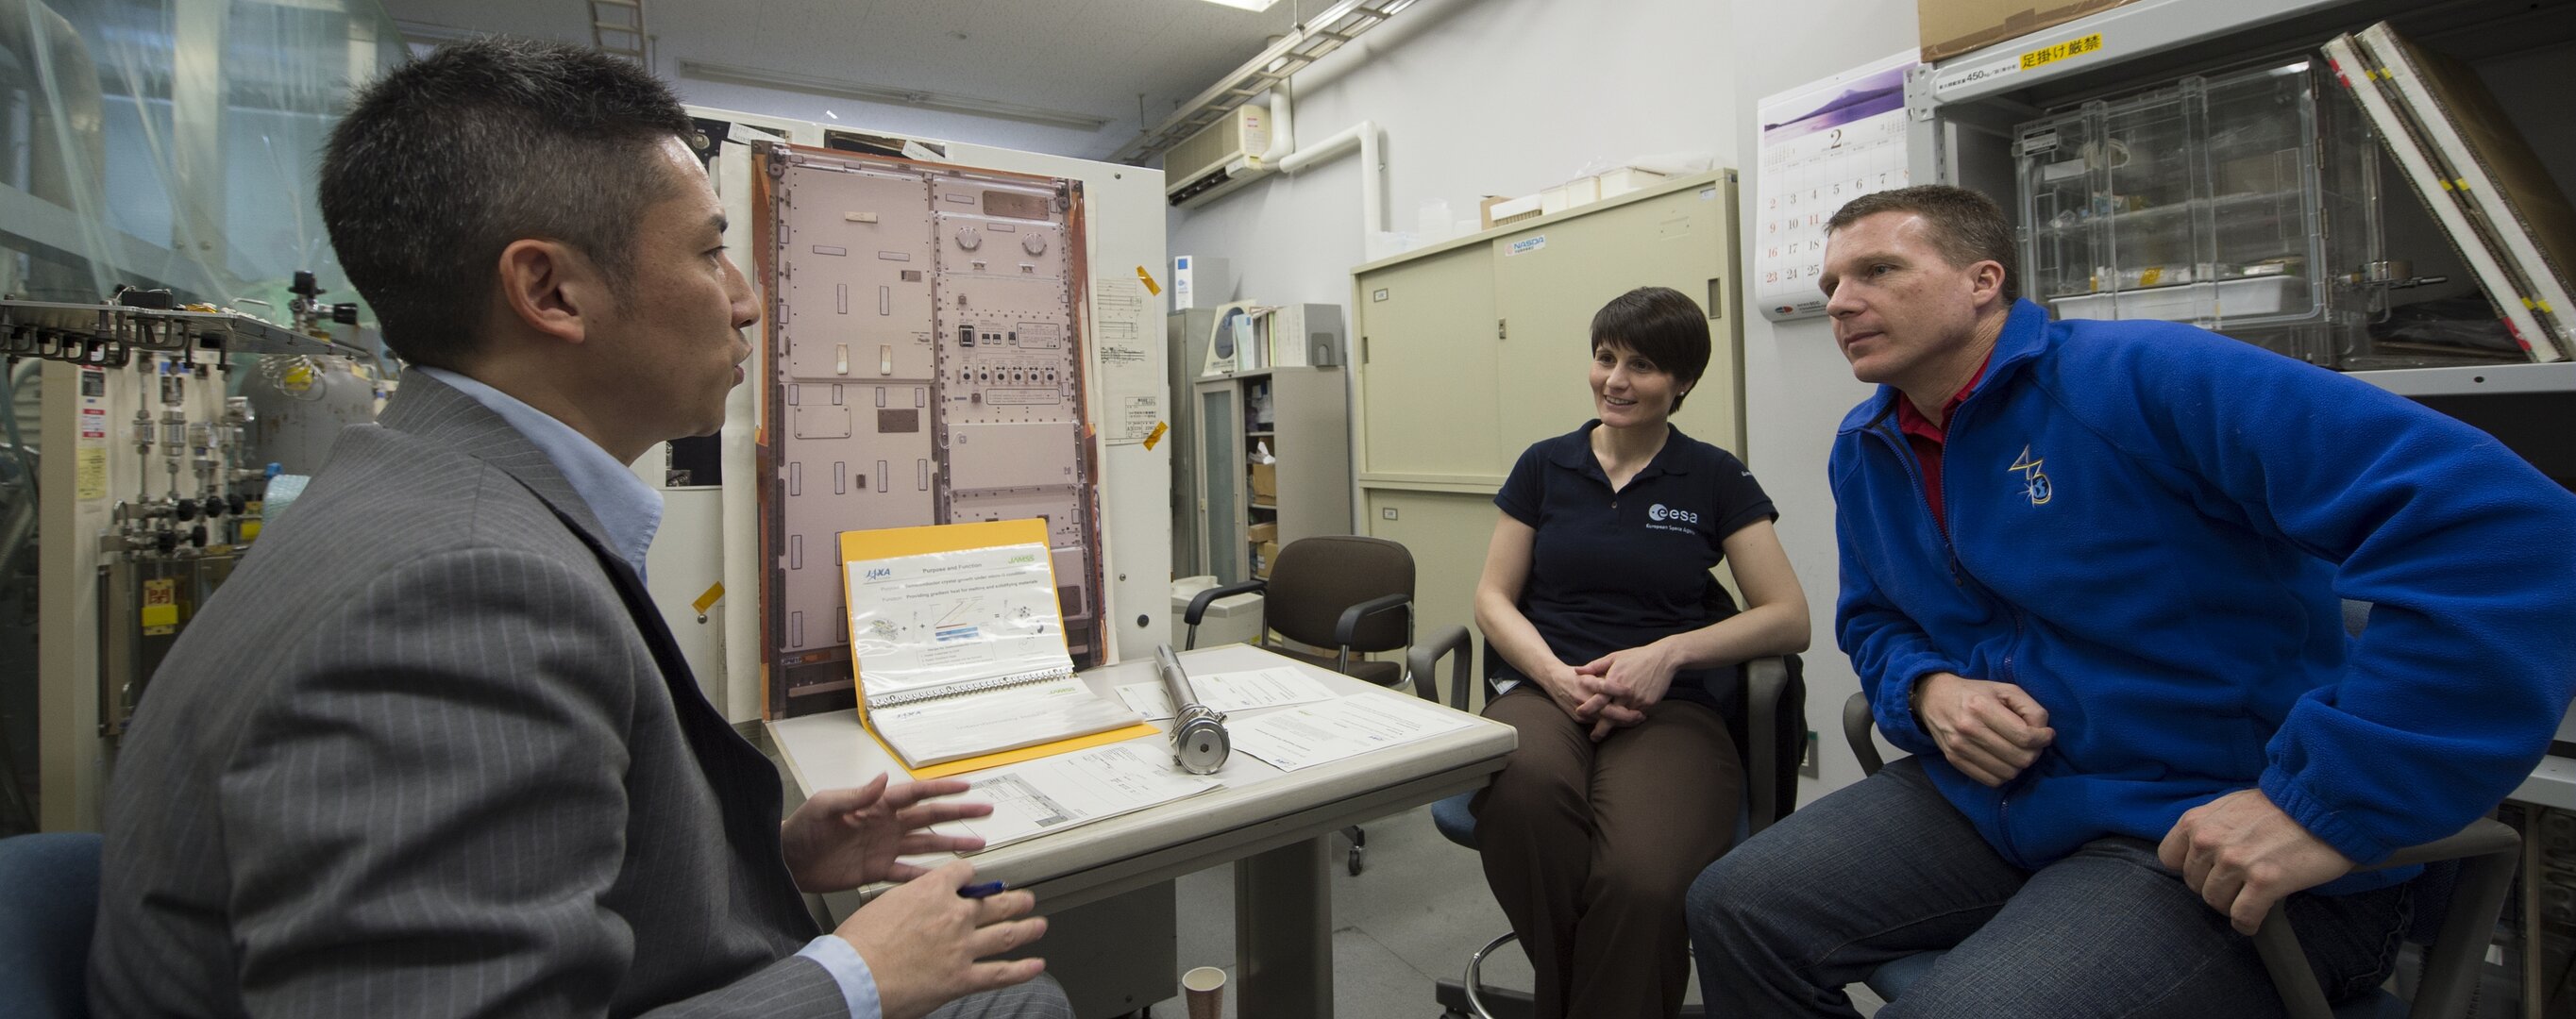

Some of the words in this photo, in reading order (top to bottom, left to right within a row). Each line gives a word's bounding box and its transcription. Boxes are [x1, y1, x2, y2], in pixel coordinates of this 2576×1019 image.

[2021, 34, 2100, 70] 足掛け厳禁
[1830, 128, 1842, 149] 2
[1770, 198, 1776, 209] 2
[1790, 192, 1797, 205] 3
[1833, 184, 1840, 195] 5
[1856, 178, 1863, 190] 6
[1879, 173, 1887, 184] 7
[1769, 223, 1776, 234] 9
[1789, 218, 1799, 230] 10
[1809, 214, 1819, 226] 11
[1514, 237, 1544, 249] NASDA
[1767, 247, 1777, 259] 16
[1788, 242, 1798, 255] 17
[1810, 239, 1820, 251] 18
[1766, 271, 1777, 283] 23
[1786, 268, 1797, 280] 24
[1807, 264, 1820, 277] 25
[1669, 509, 1698, 524] esa
[958, 562, 983, 571] Function
[1008, 555, 1035, 564] JAMSS
[866, 568, 891, 579] JAXA
